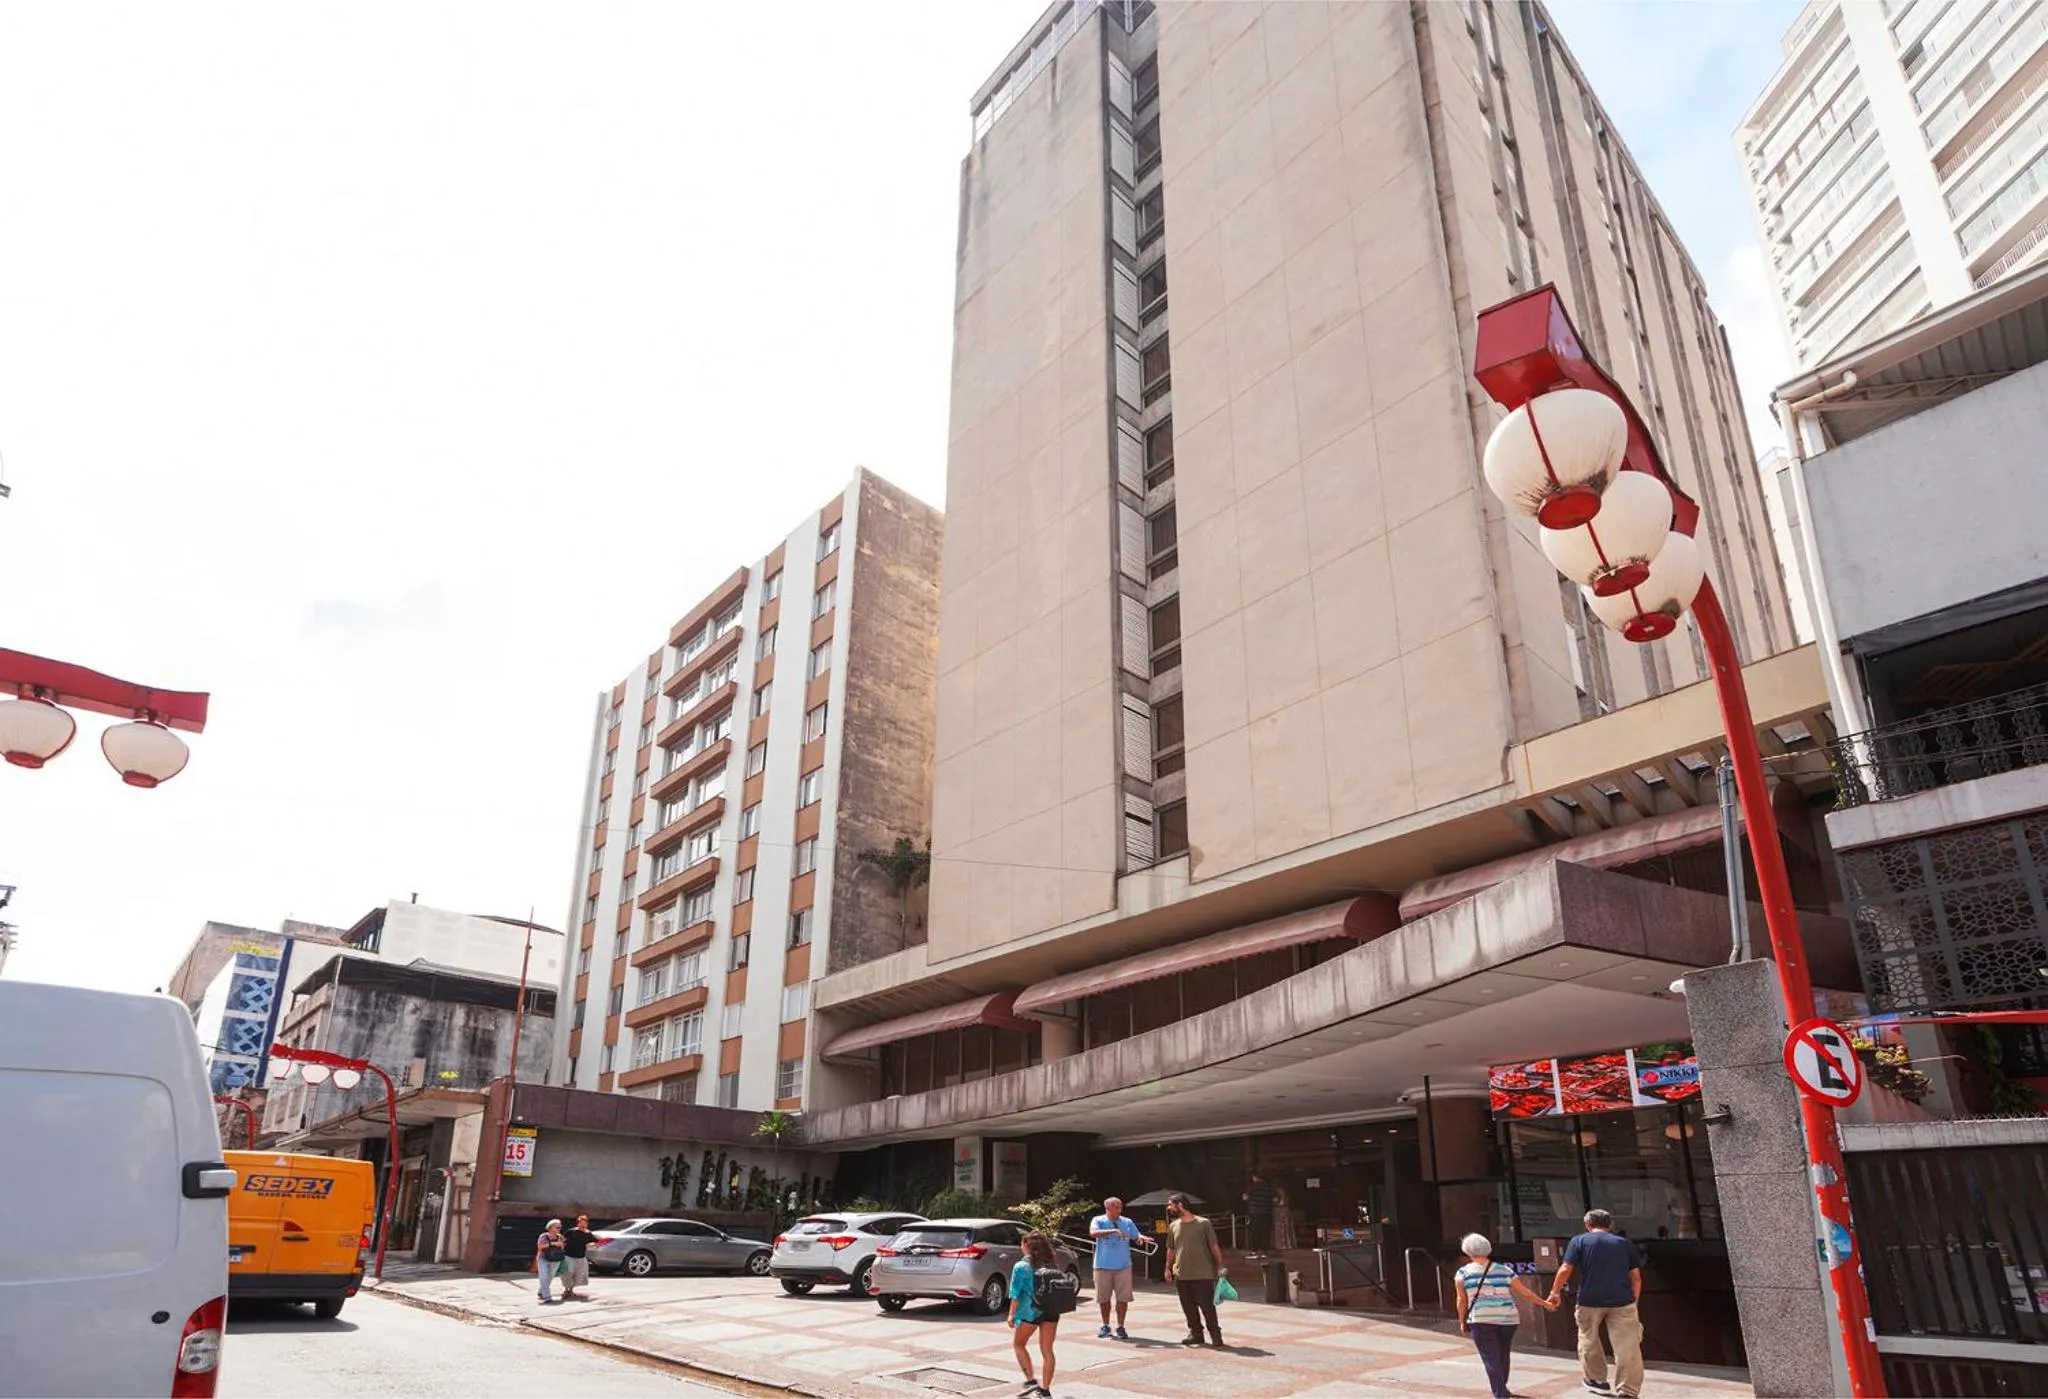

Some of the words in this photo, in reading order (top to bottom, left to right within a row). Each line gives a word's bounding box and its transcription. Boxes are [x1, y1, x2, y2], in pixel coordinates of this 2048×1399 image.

[1812, 1034, 1849, 1091] E
[506, 1143, 525, 1160] 15
[245, 1174, 332, 1195] SEDEX
